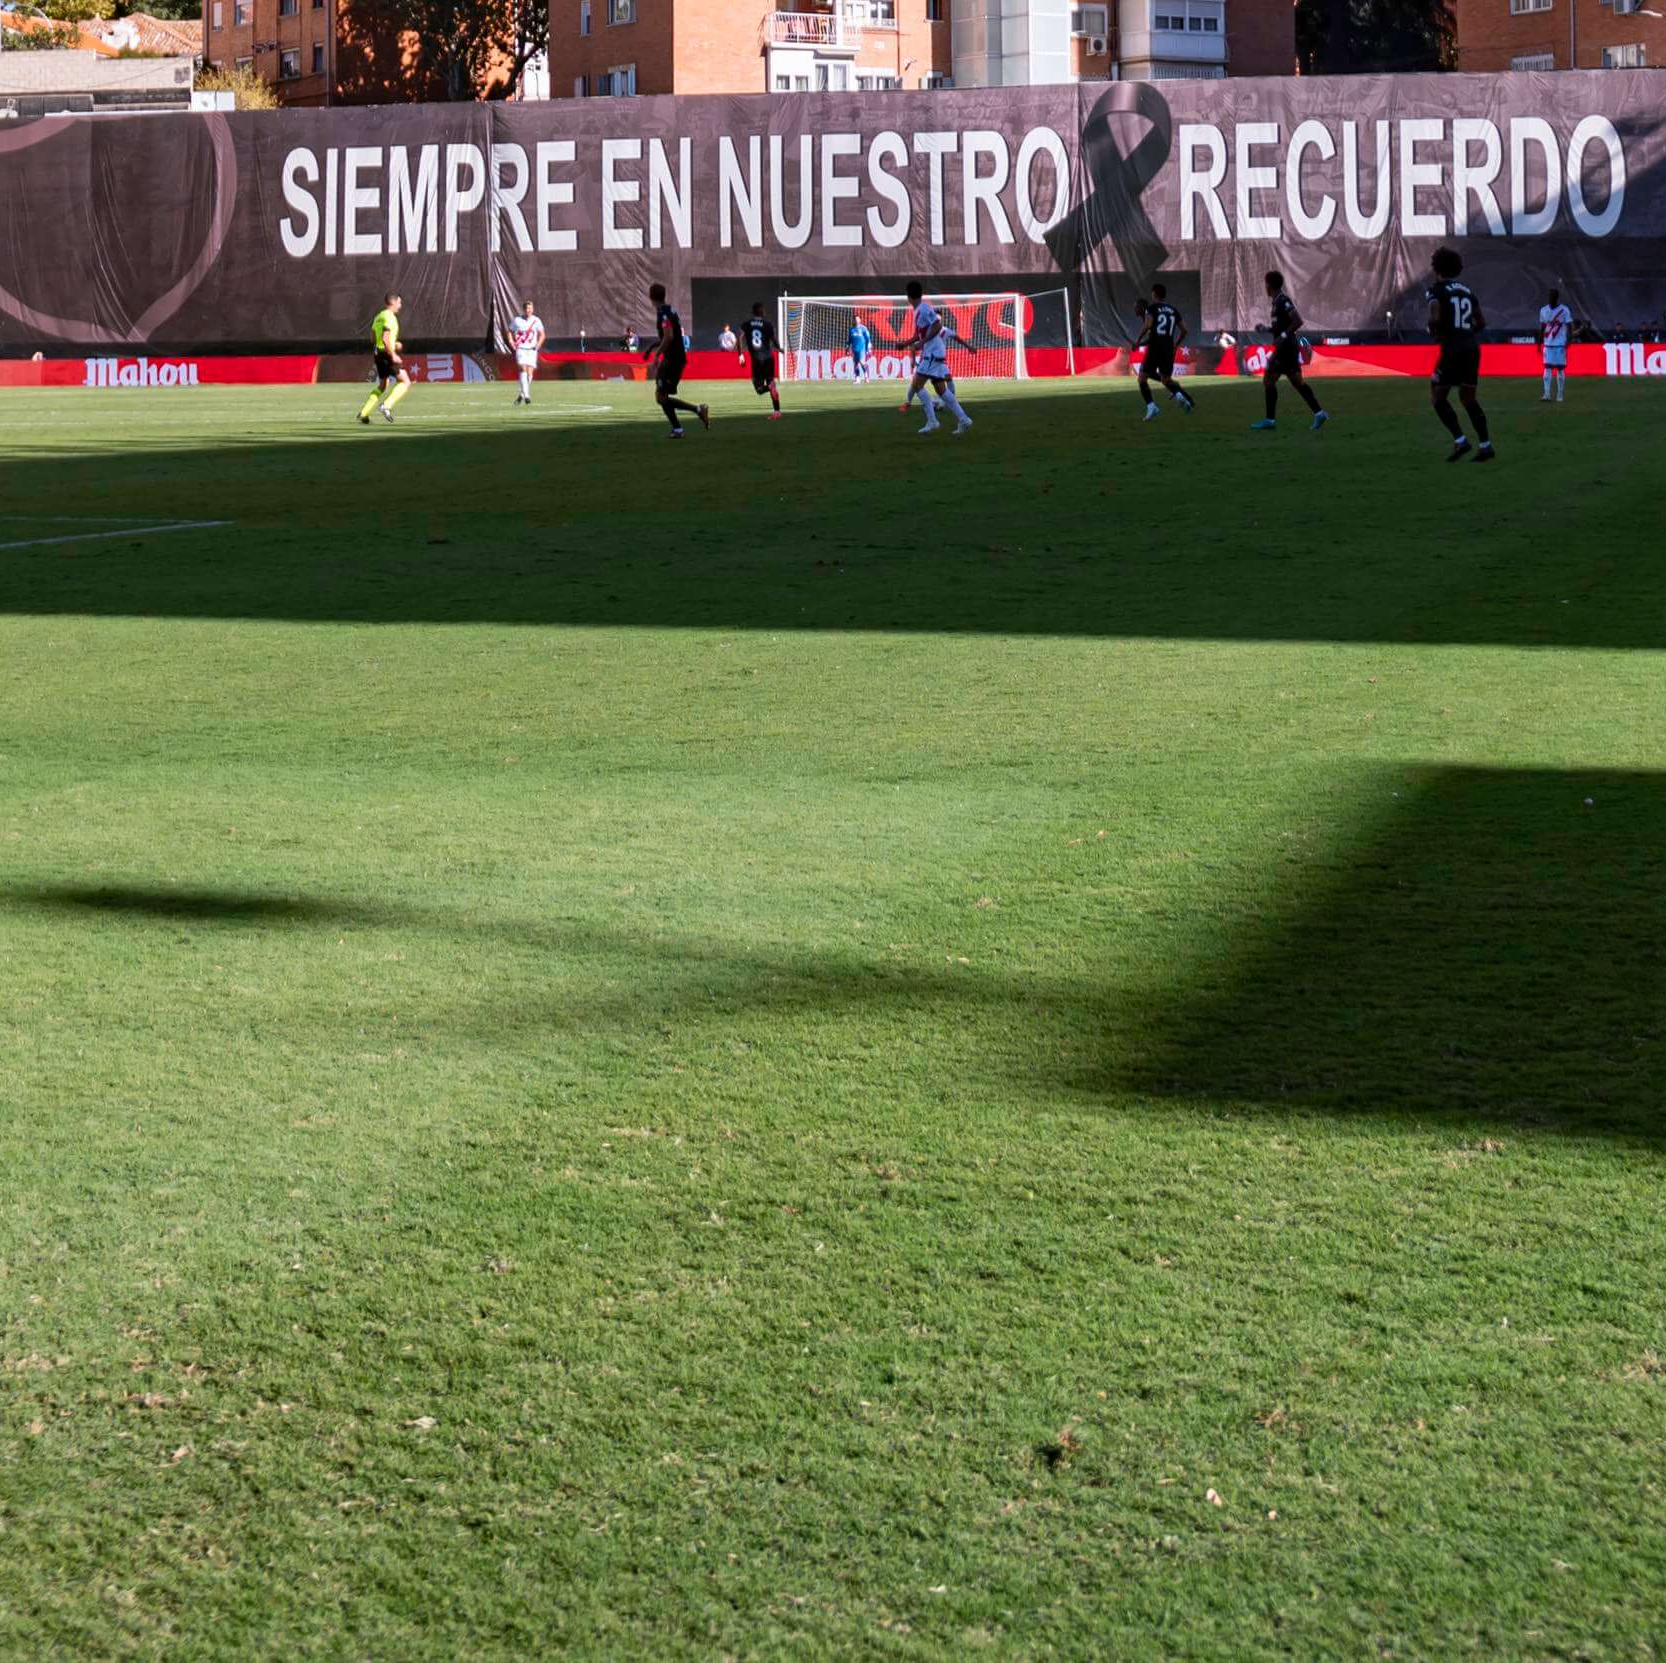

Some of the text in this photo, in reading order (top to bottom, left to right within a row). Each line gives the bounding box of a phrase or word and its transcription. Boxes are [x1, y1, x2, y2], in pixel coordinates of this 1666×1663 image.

[279, 114, 1626, 257] SIEMPRE EN NUESTRO RECUERDO
[1157, 314, 1175, 336] 21
[1450, 297, 1471, 329] 12
[752, 330, 762, 348] 8
[84, 357, 199, 386] Mahou
